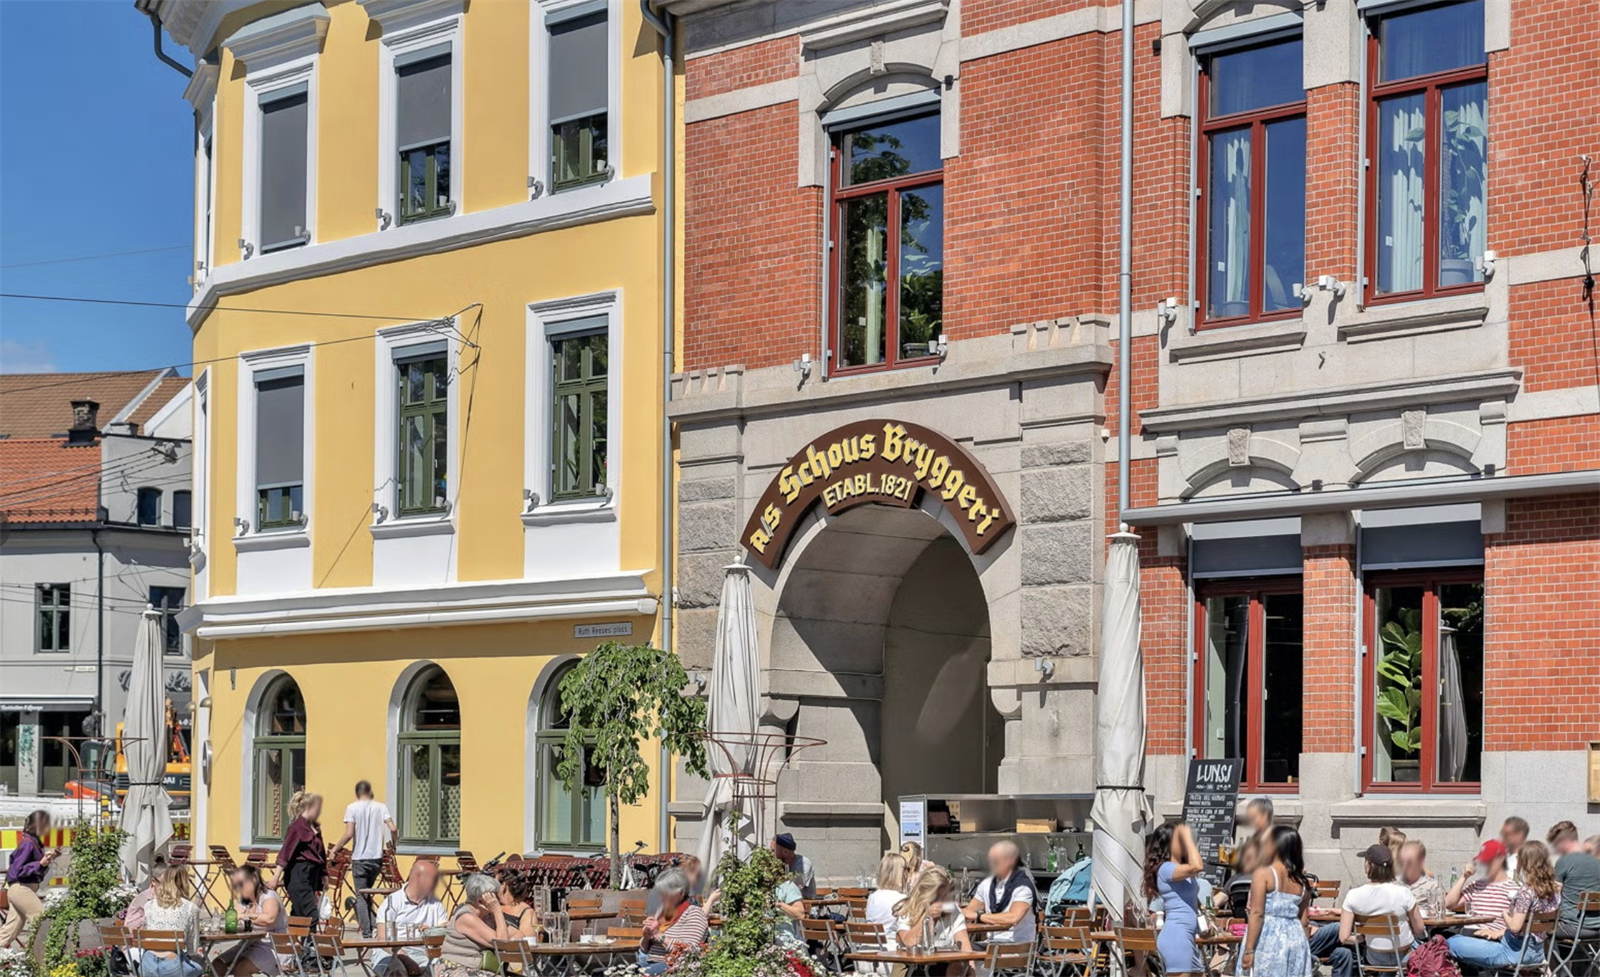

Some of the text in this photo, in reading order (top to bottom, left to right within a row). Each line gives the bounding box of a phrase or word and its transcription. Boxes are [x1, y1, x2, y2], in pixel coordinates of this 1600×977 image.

[750, 423, 1000, 554] A/S Schous Bryggeri
[578, 626, 628, 635] Ruth Reeses plass
[1196, 764, 1233, 783] LUNSJ
